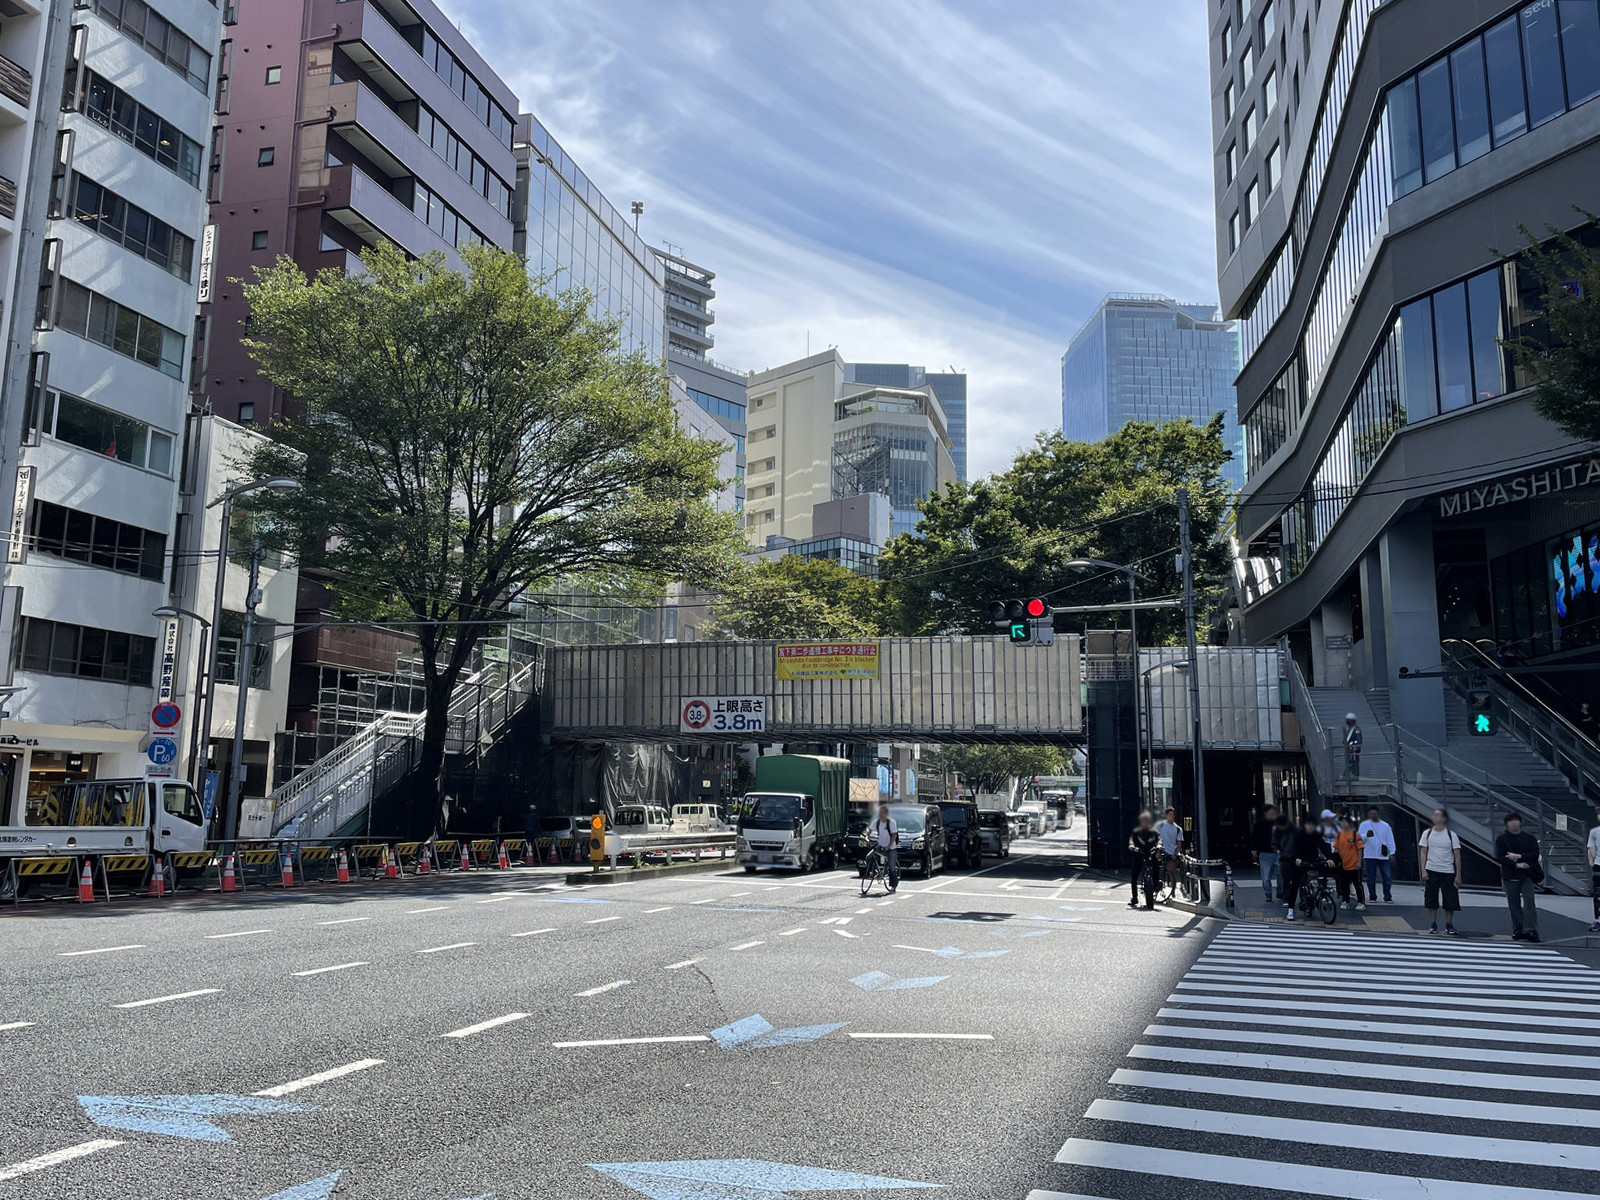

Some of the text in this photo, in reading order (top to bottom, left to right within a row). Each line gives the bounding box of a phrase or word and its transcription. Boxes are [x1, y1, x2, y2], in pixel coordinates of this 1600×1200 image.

[1440, 459, 1600, 518] MIYASHITA
[713, 699, 764, 713] 上限高さ
[714, 714, 762, 730] 3.8m
[153, 744, 166, 762] P
[161, 753, 171, 762] 60
